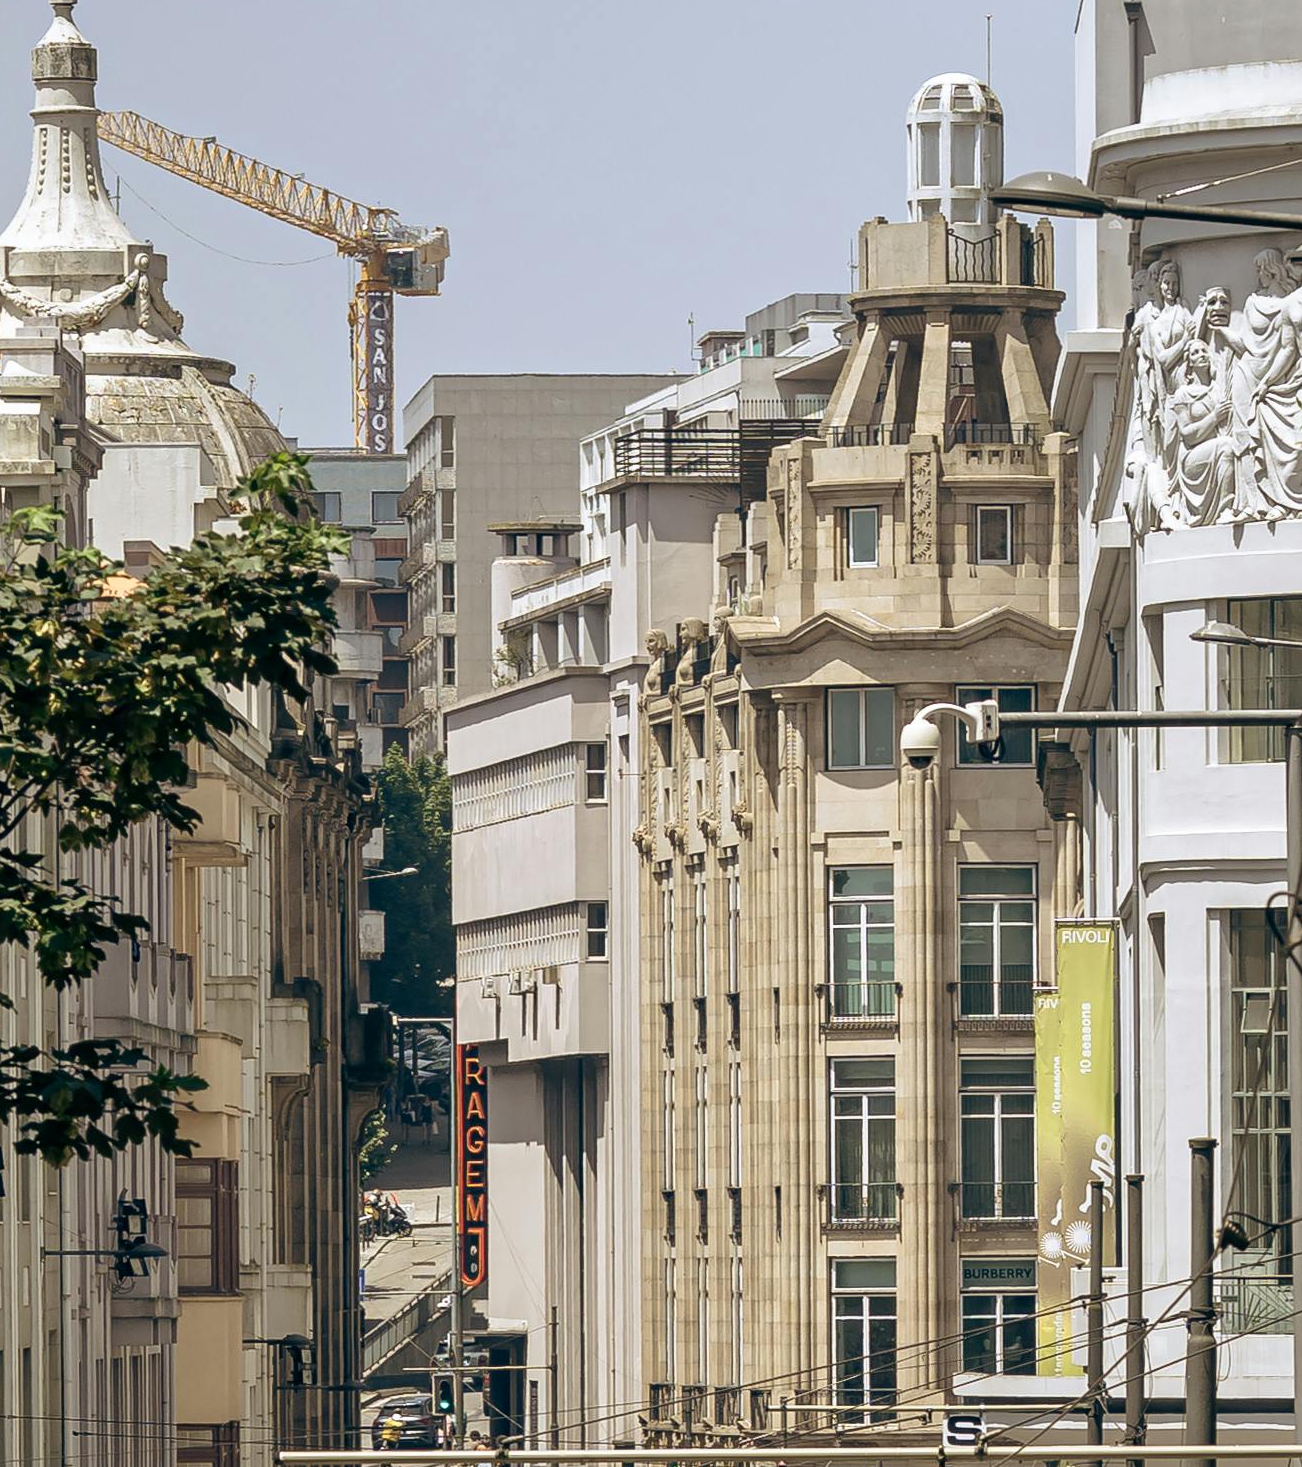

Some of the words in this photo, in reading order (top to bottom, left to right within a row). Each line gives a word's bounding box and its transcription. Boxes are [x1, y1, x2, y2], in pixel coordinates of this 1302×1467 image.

[372, 329, 387, 384] SAN
[1061, 930, 1110, 944] RIVOLI
[1081, 1002, 1092, 1058] seasons
[1080, 1058, 1092, 1075] 10
[1052, 1102, 1061, 1114] 10
[464, 1044, 486, 1222] RAGEM
[964, 1268, 1032, 1279] BURBERRY
